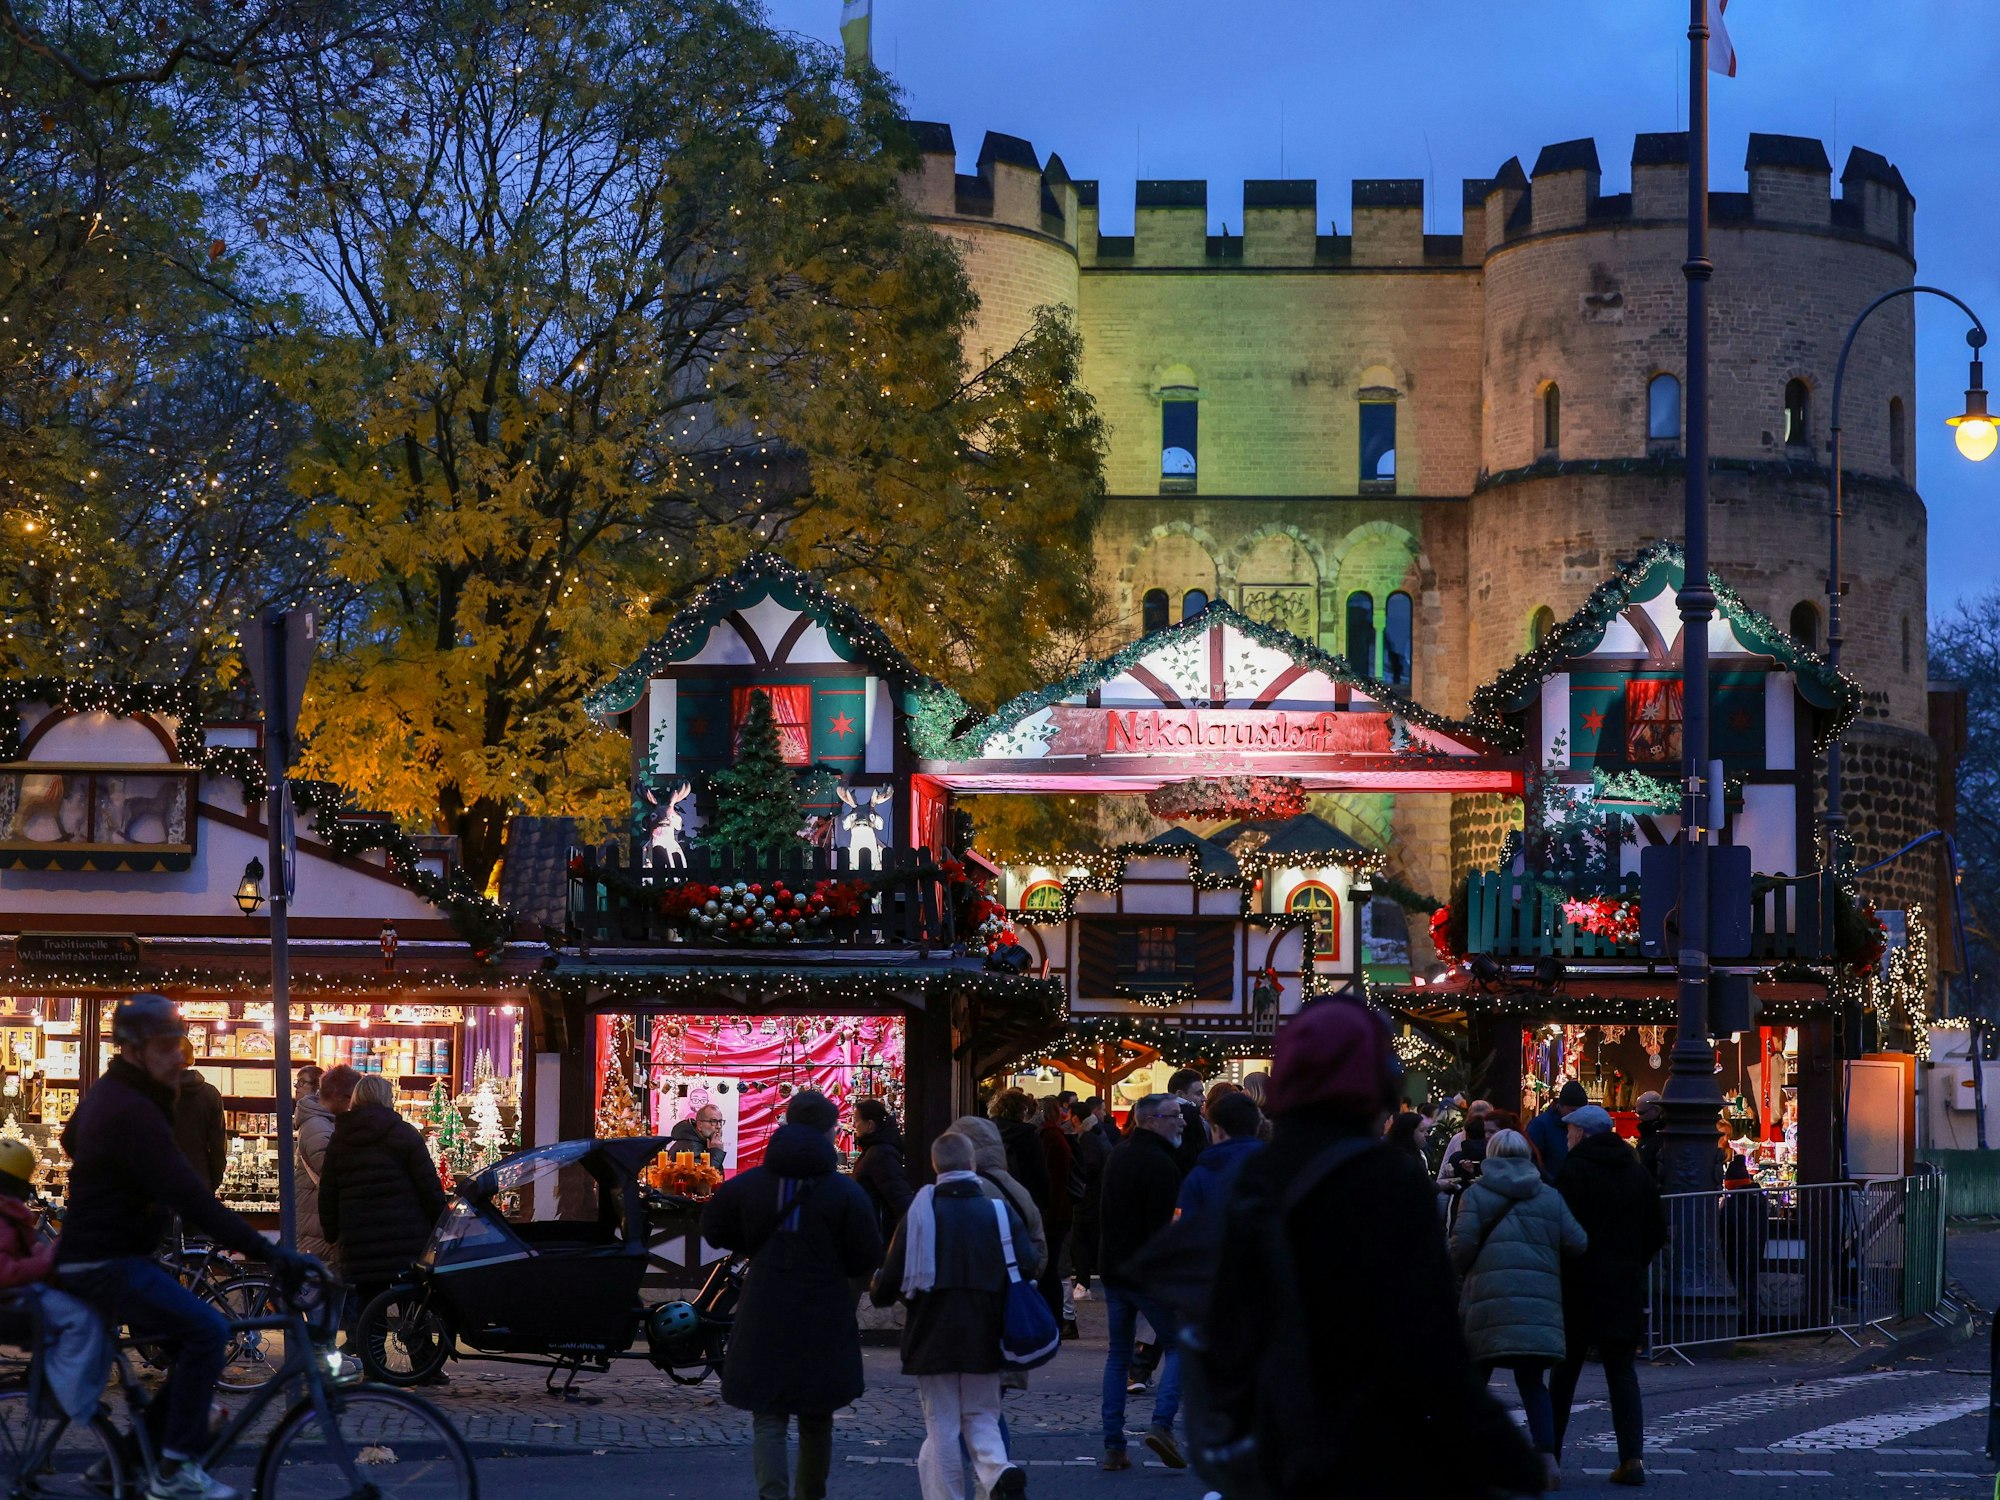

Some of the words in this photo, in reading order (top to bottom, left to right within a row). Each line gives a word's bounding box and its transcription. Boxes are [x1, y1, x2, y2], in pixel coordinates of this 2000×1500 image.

[1105, 709, 1338, 752] Nikolausdorf
[42, 939, 109, 950] Traditionelle
[18, 950, 137, 961] Weihnachtsdekoration
